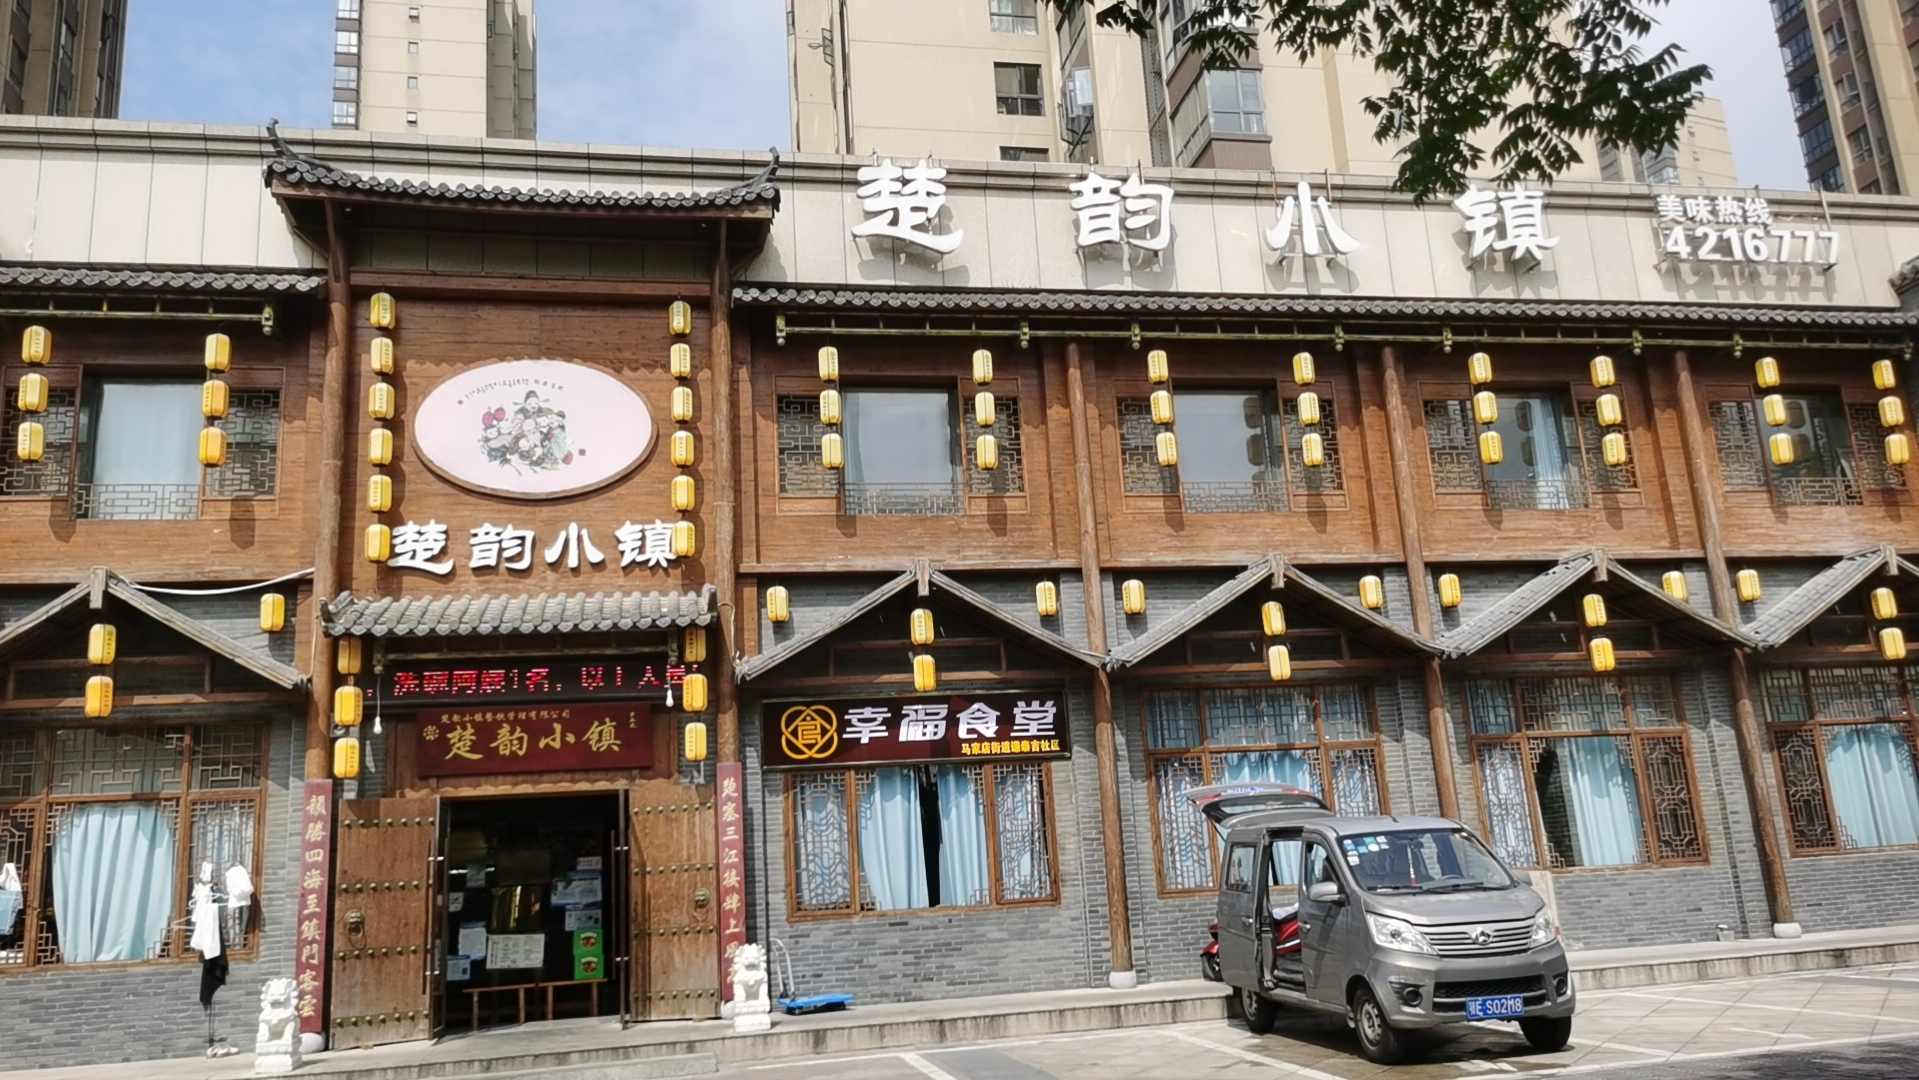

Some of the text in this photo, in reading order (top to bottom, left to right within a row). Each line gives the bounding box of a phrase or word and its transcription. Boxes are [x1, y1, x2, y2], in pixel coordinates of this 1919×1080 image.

[850, 158, 1560, 261] 楚韵小镇
[1656, 194, 1773, 225] 美味热线
[1665, 226, 1839, 264] 4216777
[387, 519, 680, 575] 楚韵小镇
[444, 717, 622, 760] 楚韵小镇
[842, 701, 1057, 744] 幸福食堂
